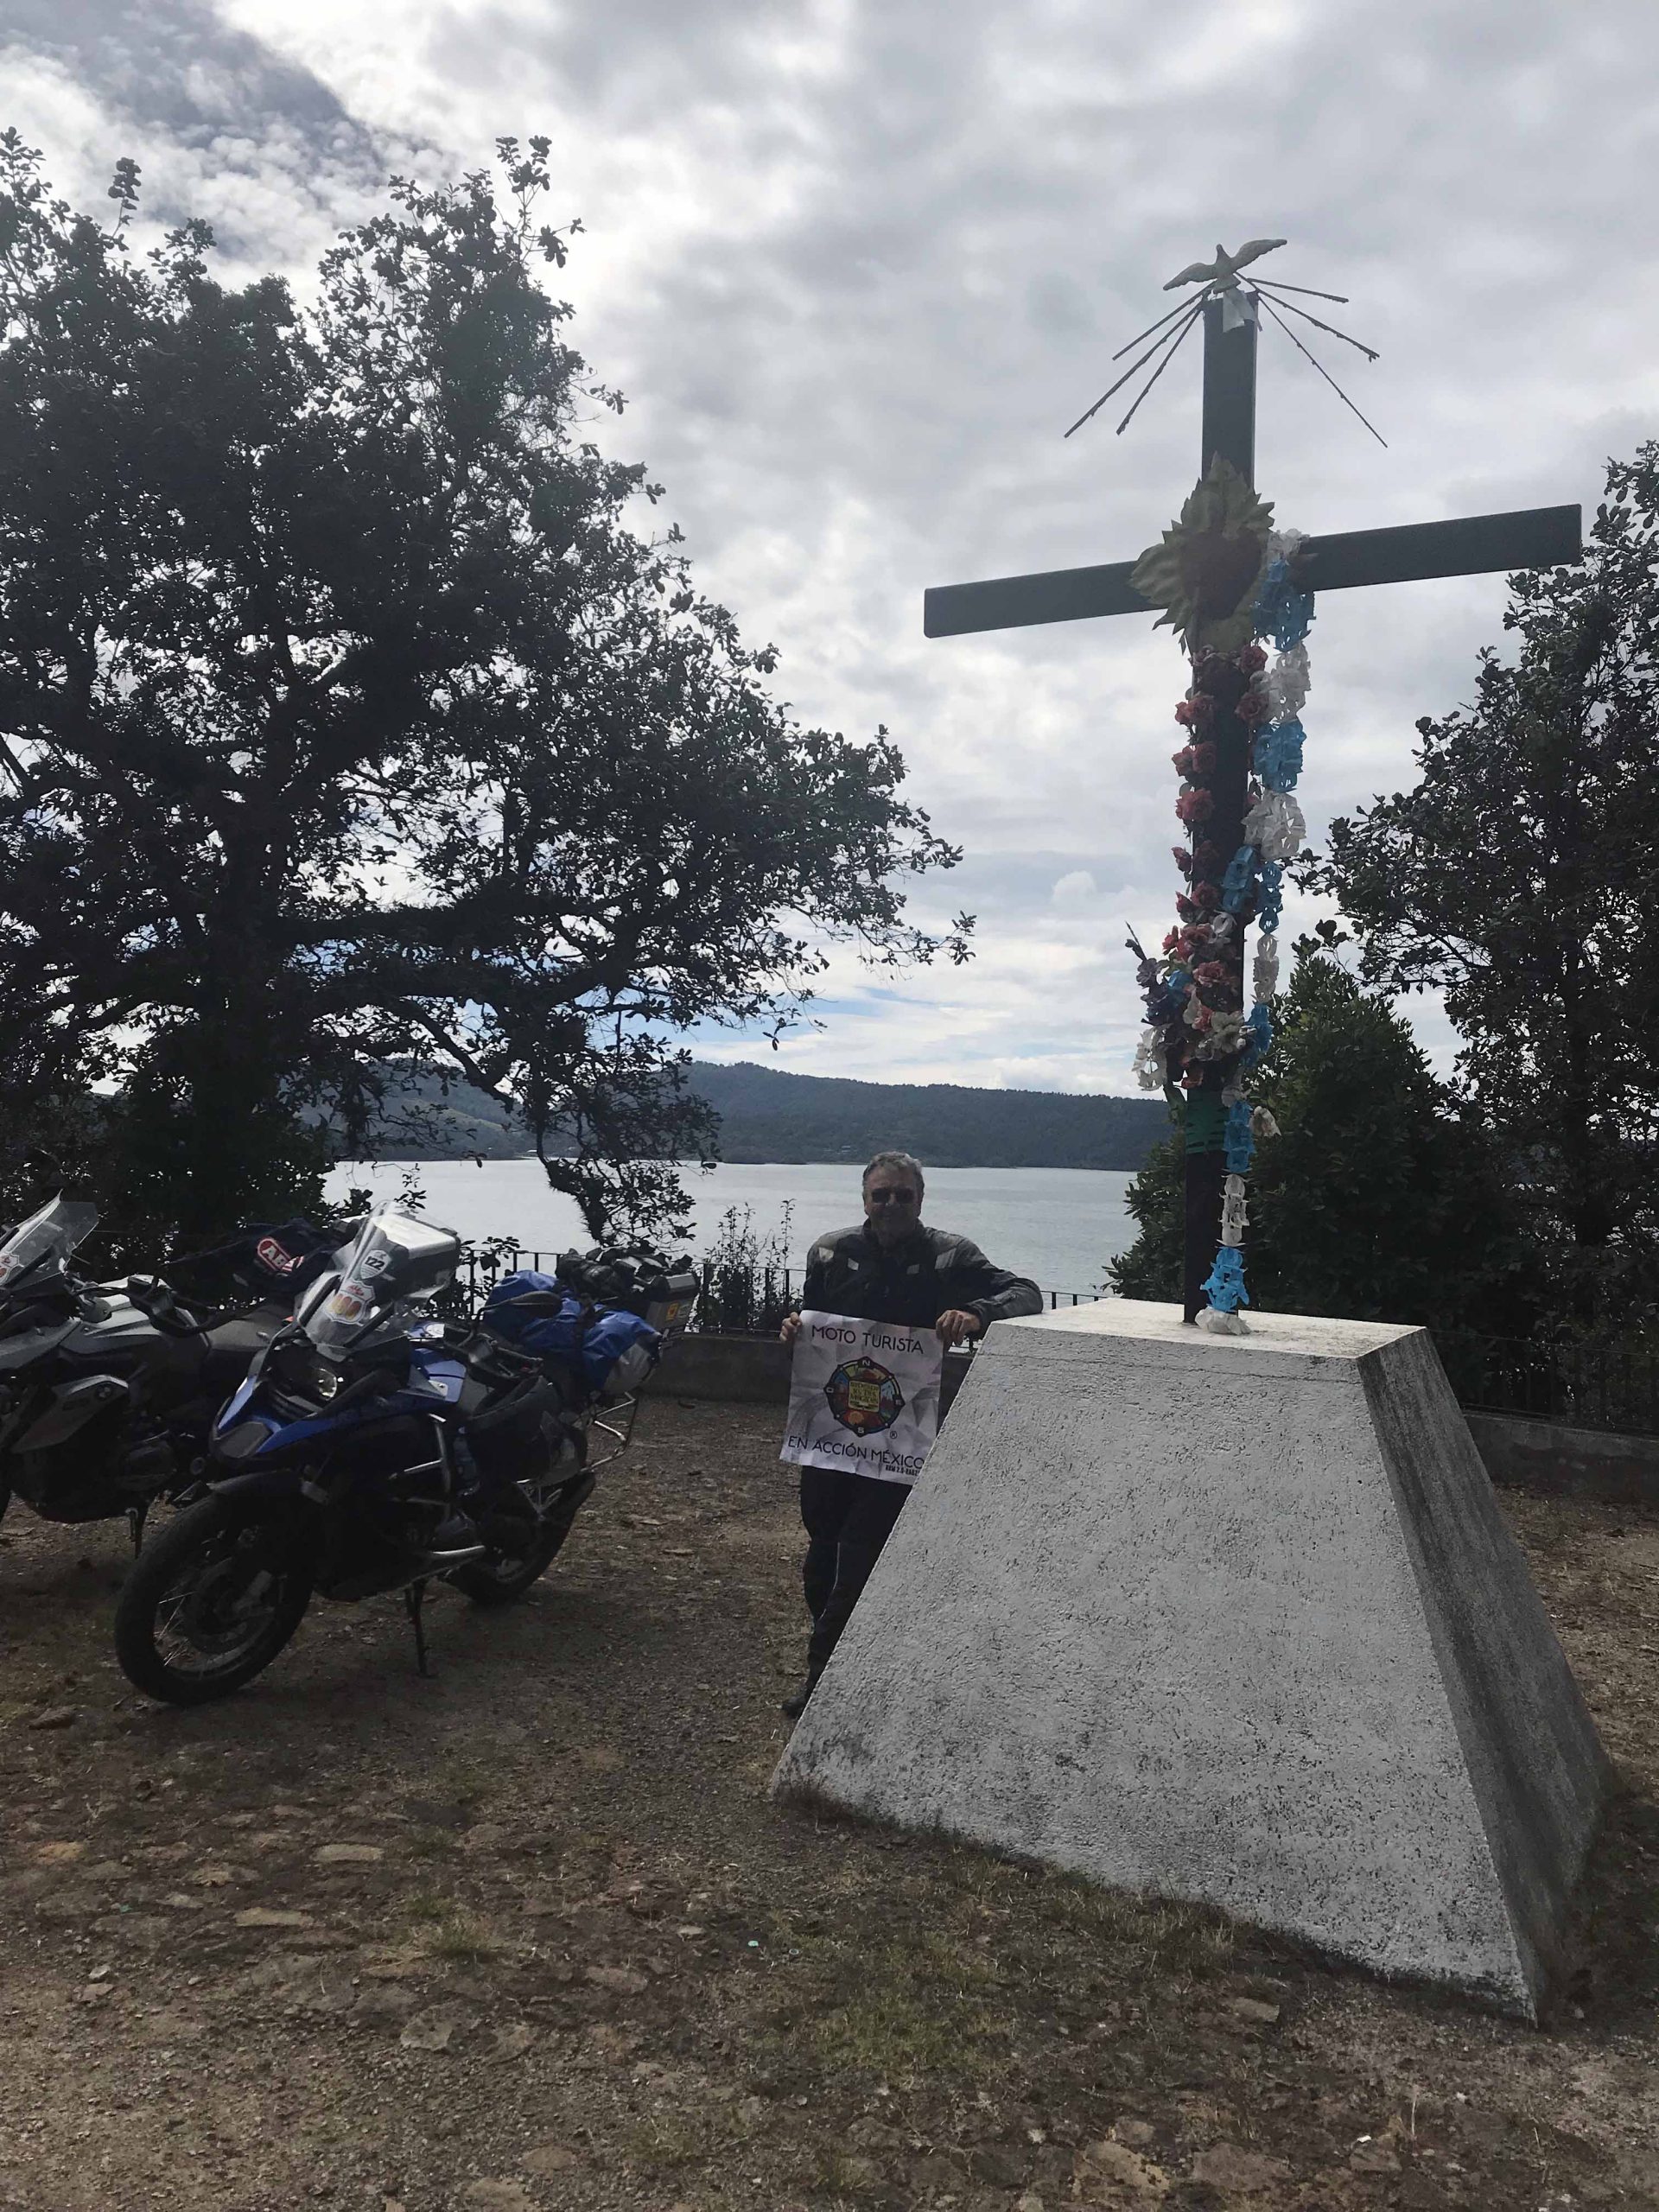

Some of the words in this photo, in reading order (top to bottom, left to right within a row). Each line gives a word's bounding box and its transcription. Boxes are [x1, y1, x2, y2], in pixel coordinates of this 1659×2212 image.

[365, 1255, 385, 1271] 122
[811, 1325, 855, 1344] MOTO
[862, 1332, 924, 1354] TURISTA
[788, 1435, 807, 1449] EN
[812, 1442, 867, 1459] ACCIÓN
[871, 1449, 925, 1469] MÉXICO
